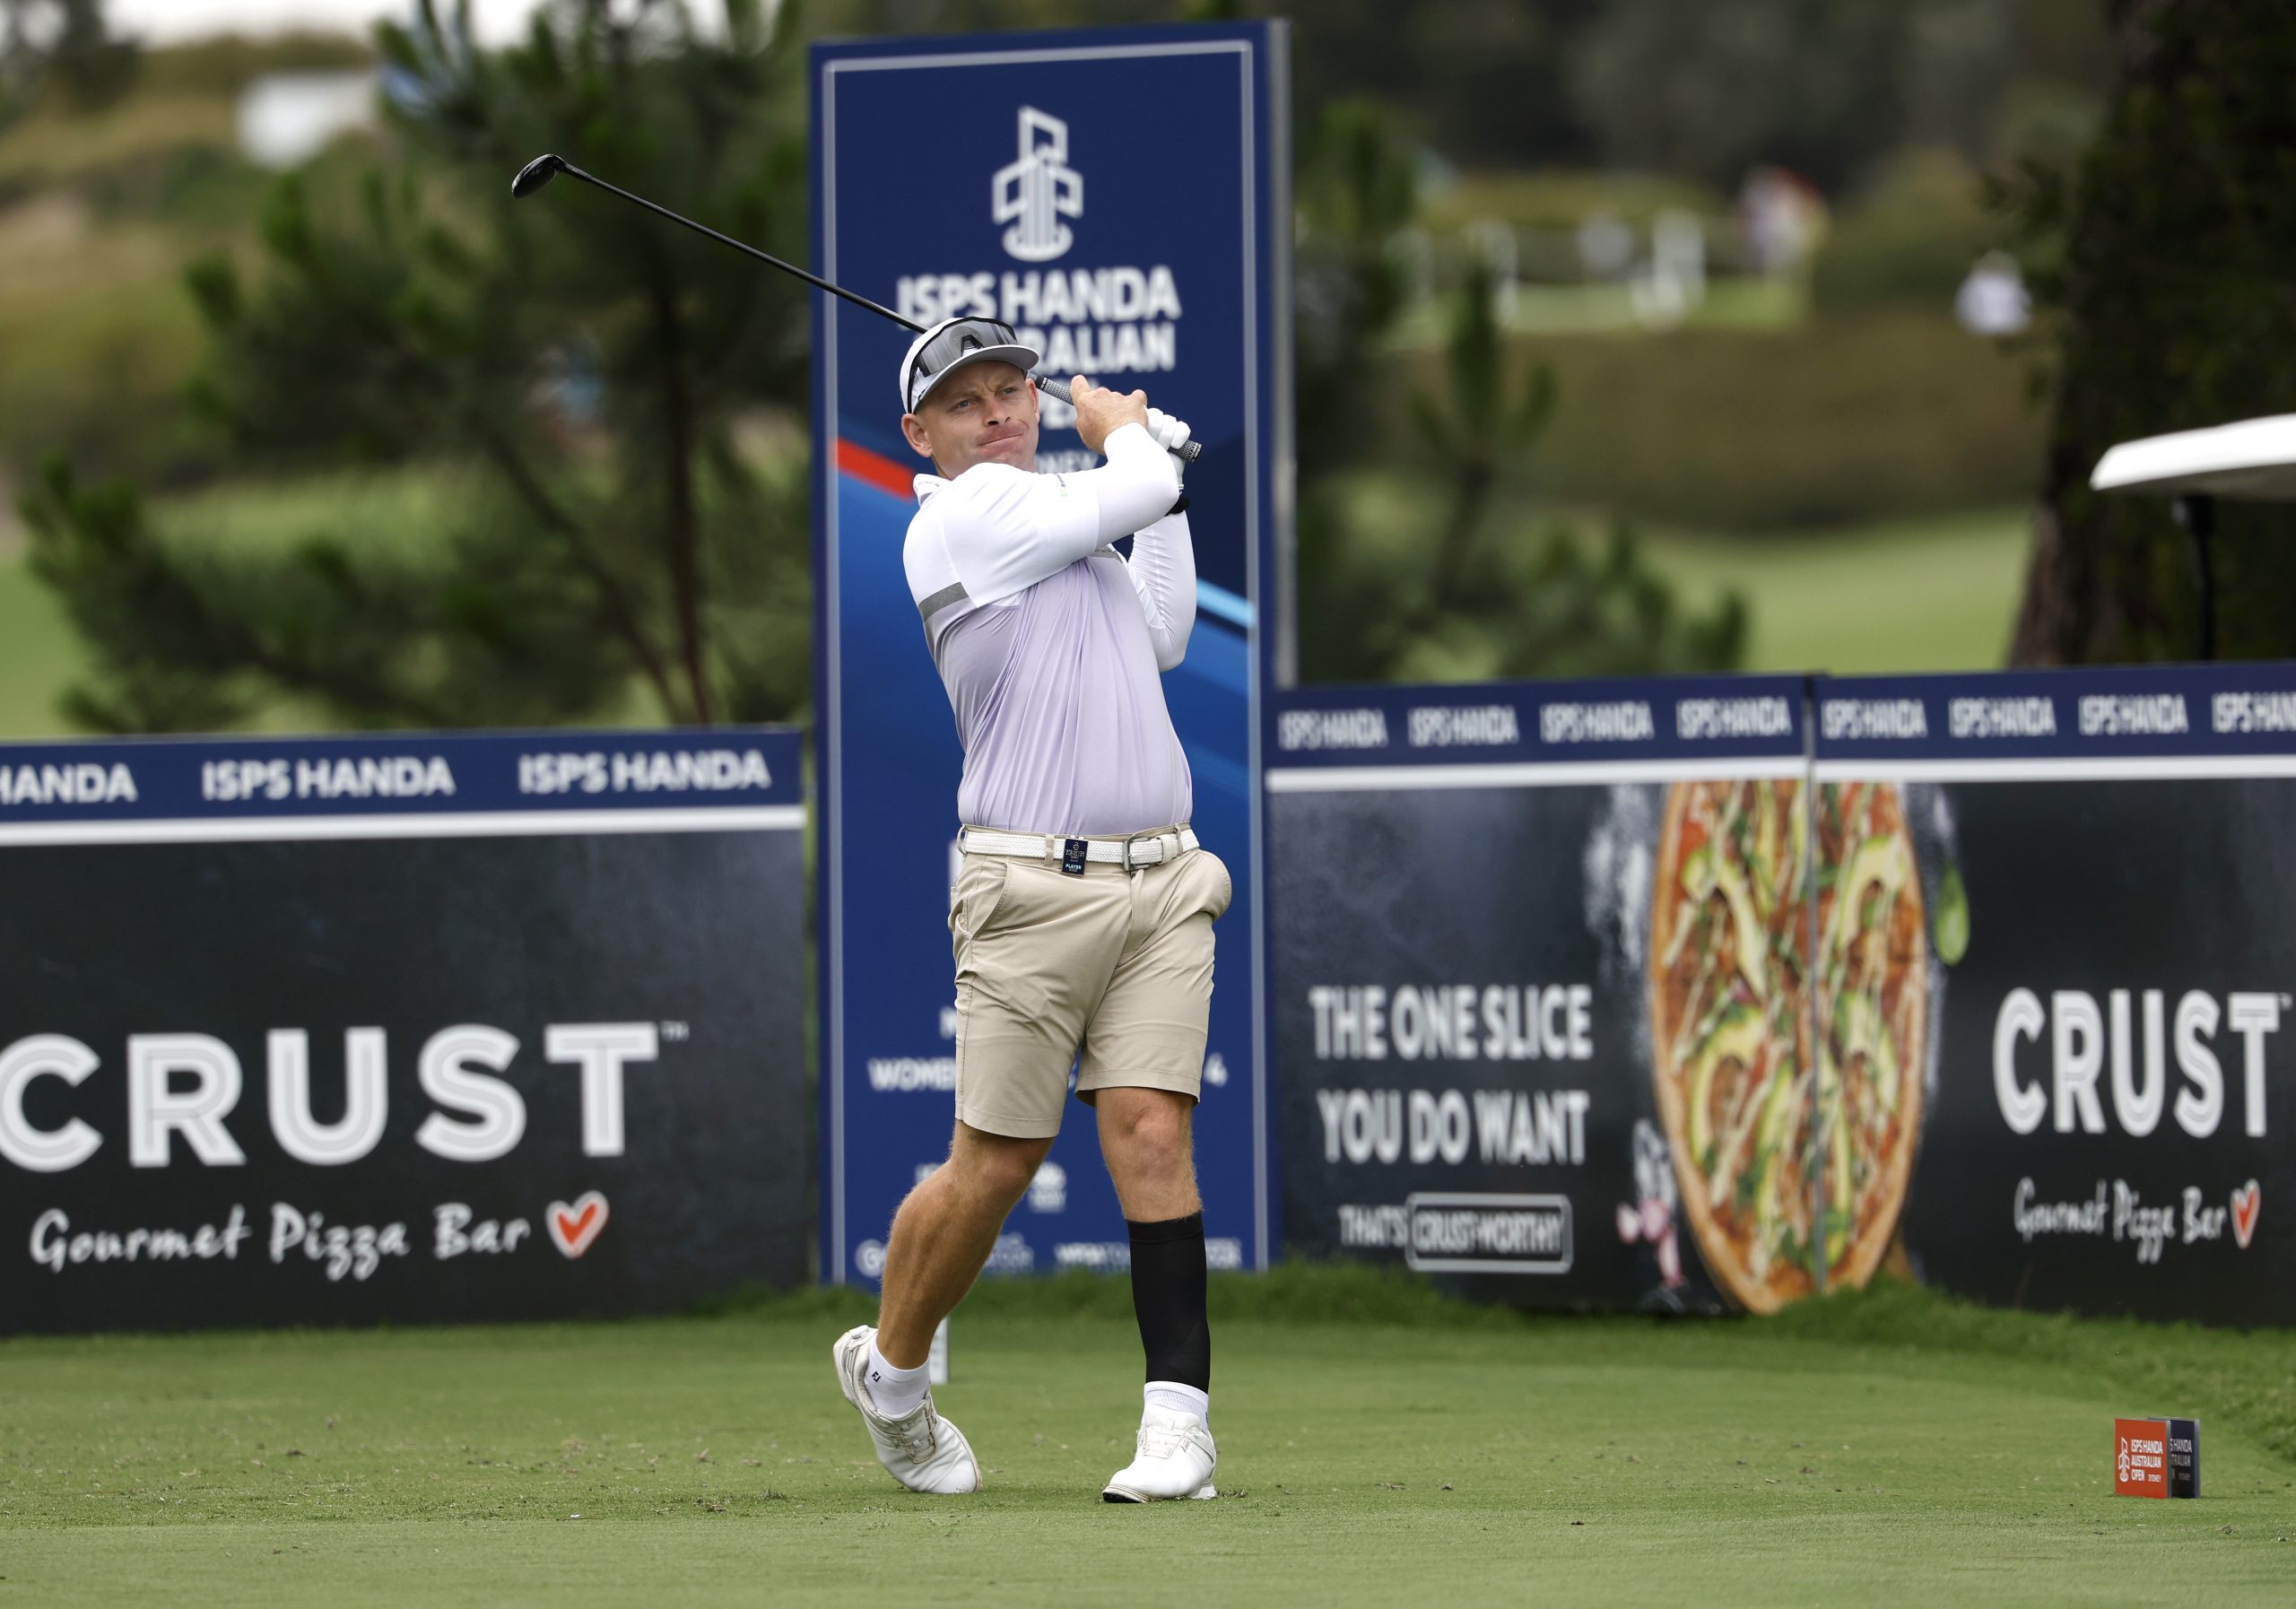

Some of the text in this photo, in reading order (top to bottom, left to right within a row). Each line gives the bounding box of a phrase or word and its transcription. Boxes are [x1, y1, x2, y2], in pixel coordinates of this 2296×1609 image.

[897, 265, 1181, 327] ISPS HANDA
[202, 755, 457, 802] ISPS HANDA
[518, 749, 772, 796] ISPS HANDA
[1309, 984, 1594, 1060] THE ONE SLICE
[1992, 987, 2281, 1139] CRUST
[0, 1023, 658, 1172] CRUST
[1316, 1089, 1590, 1164] YOU DO WANT
[30, 1202, 531, 1281] Gourmet Pizza Bar
[1339, 1205, 1407, 1247] THAT'S
[2013, 1176, 2227, 1265] Gourmet Pizza Bar
[871, 1370, 882, 1383] FJ
[2131, 1439, 2143, 1453] ISPS
[2143, 1439, 2163, 1454] HANDA
[2131, 1455, 2161, 1468] AUSTRALIAN
[2131, 1468, 2145, 1482] OPEN
